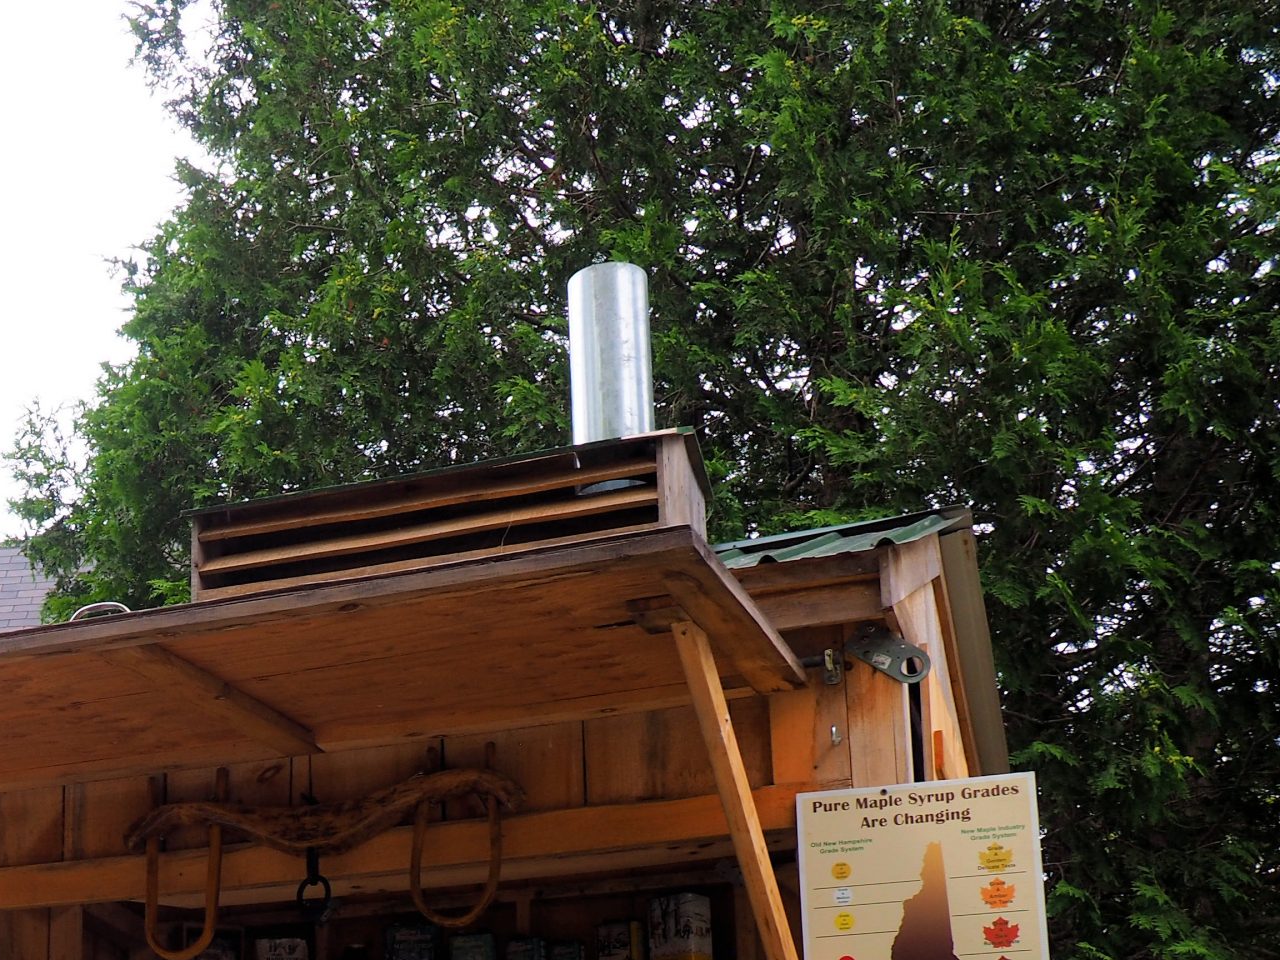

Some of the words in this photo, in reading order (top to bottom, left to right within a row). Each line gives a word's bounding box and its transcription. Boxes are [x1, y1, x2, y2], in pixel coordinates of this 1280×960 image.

[812, 800, 850, 814] Pure
[855, 795, 903, 811] Maple
[908, 790, 955, 808] Syrup
[961, 784, 1020, 800] Grades
[860, 816, 888, 829] Are
[893, 807, 972, 827] Changing
